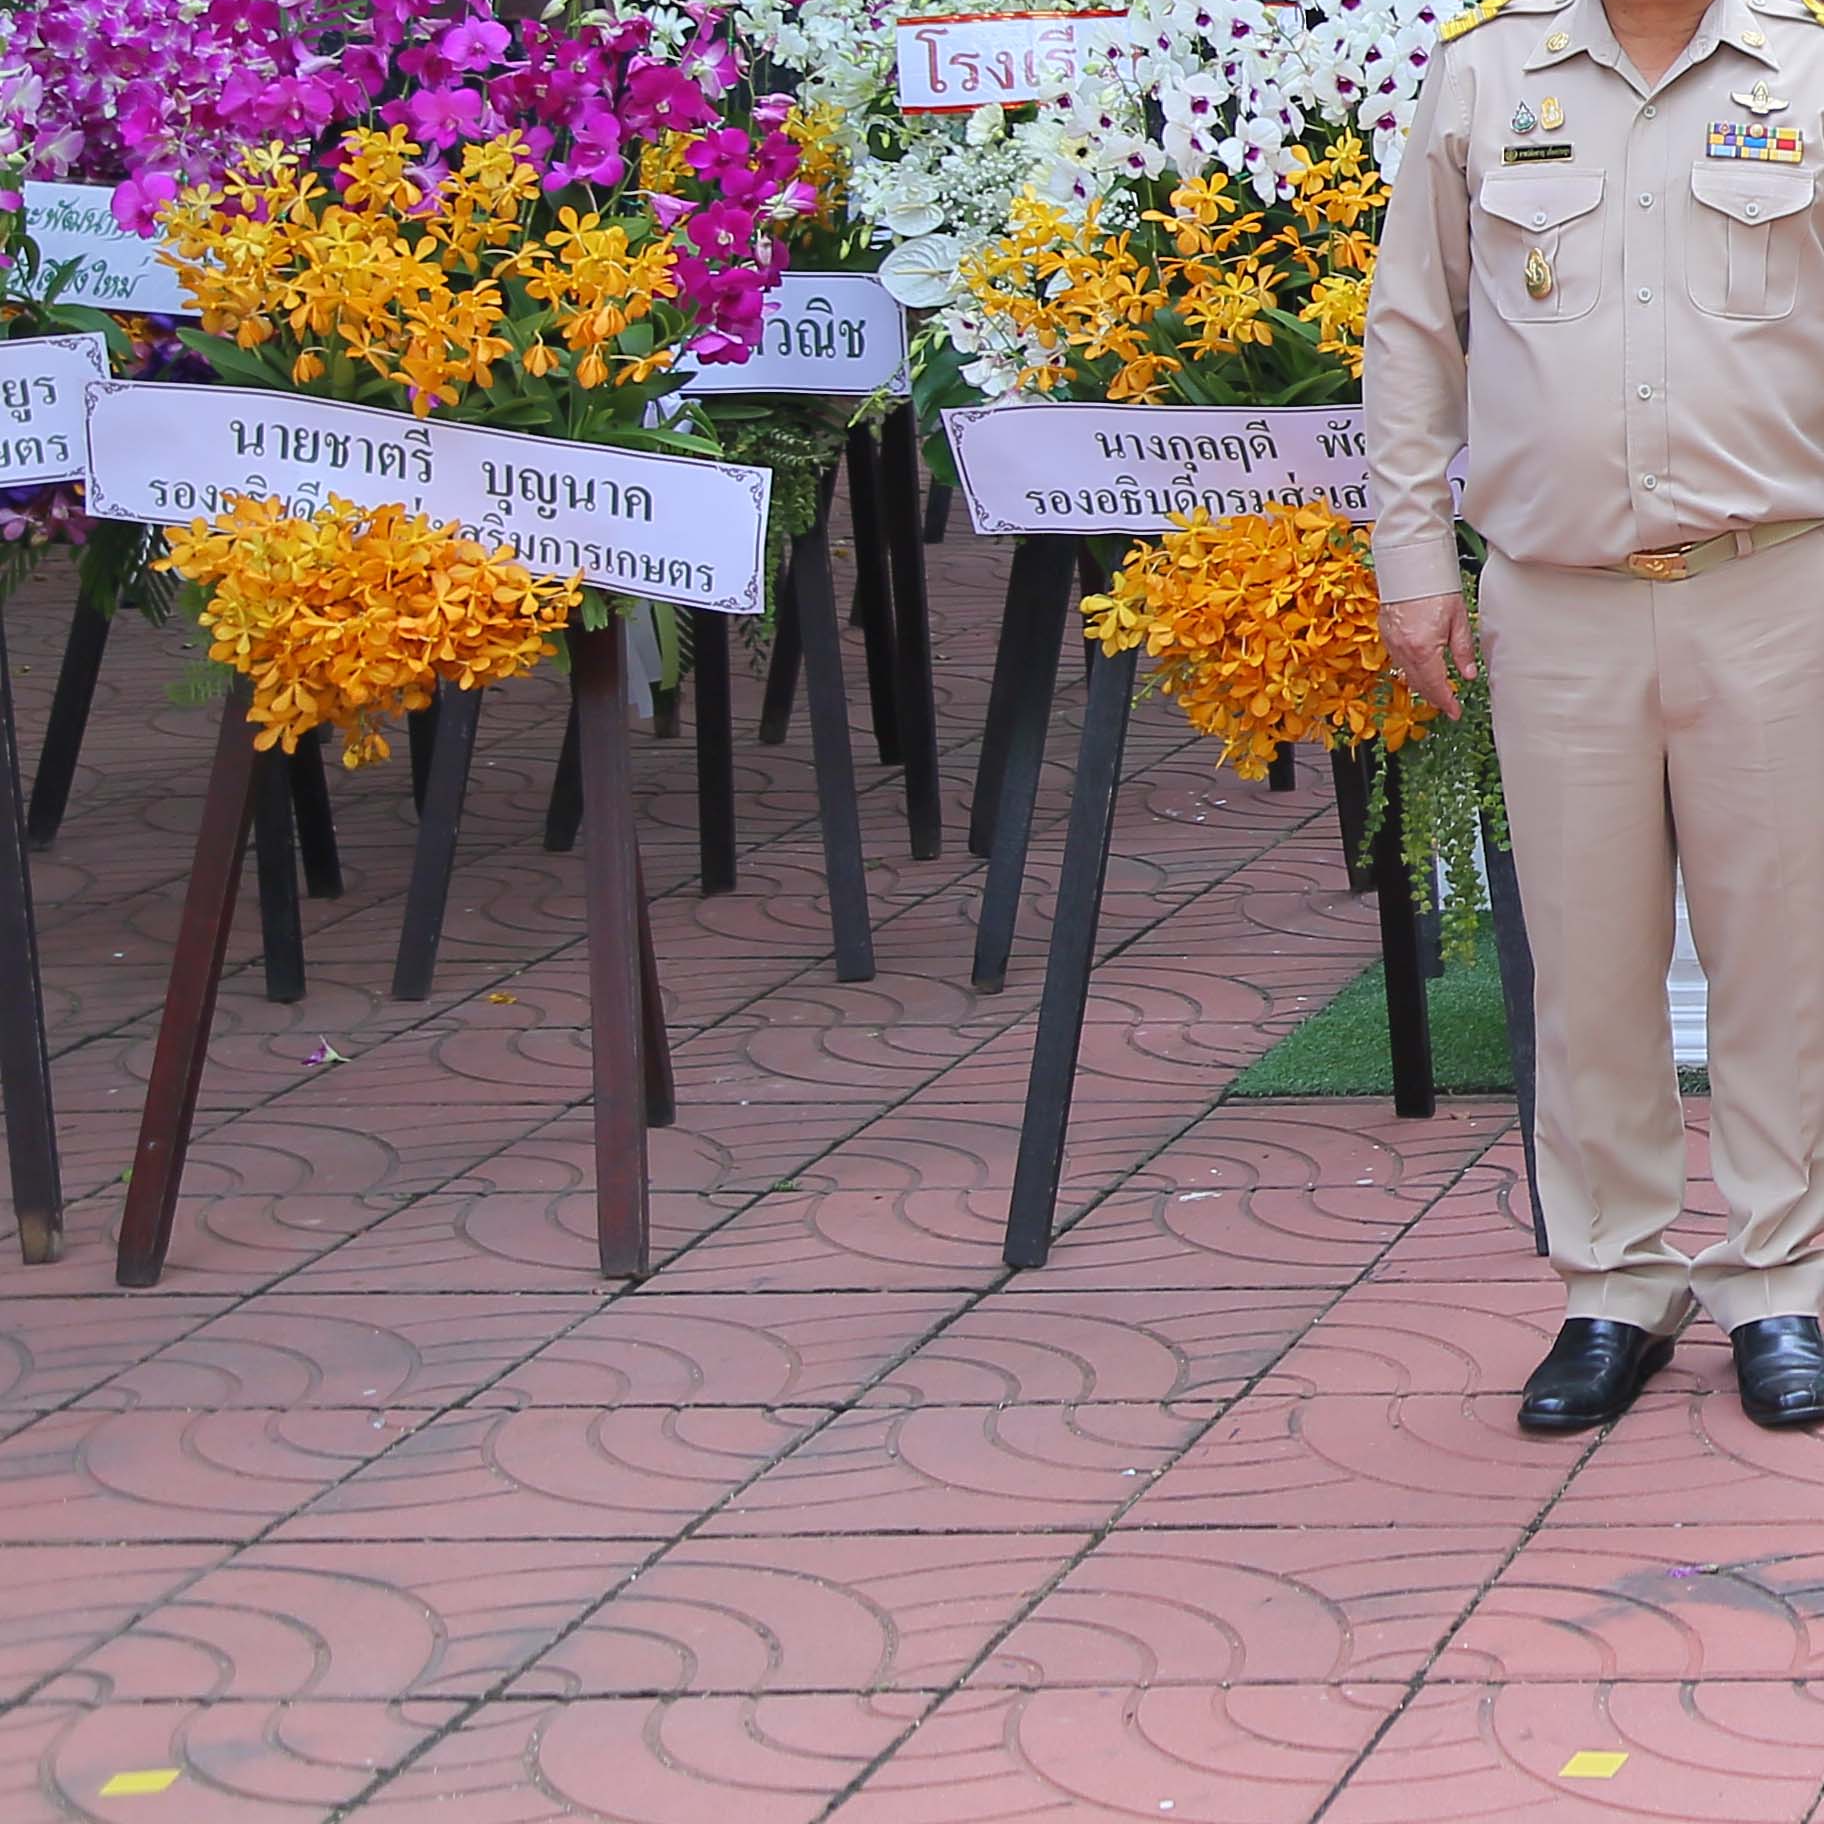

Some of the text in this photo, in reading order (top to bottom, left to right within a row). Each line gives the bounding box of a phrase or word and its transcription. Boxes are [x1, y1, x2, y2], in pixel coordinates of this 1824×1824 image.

[915, 27, 1077, 94] โรงเรี
[750, 297, 866, 359] วณิช
[229, 418, 654, 522] นายชาตรี บุญนาค
[1094, 420, 1279, 474] นางกุลฤดี
